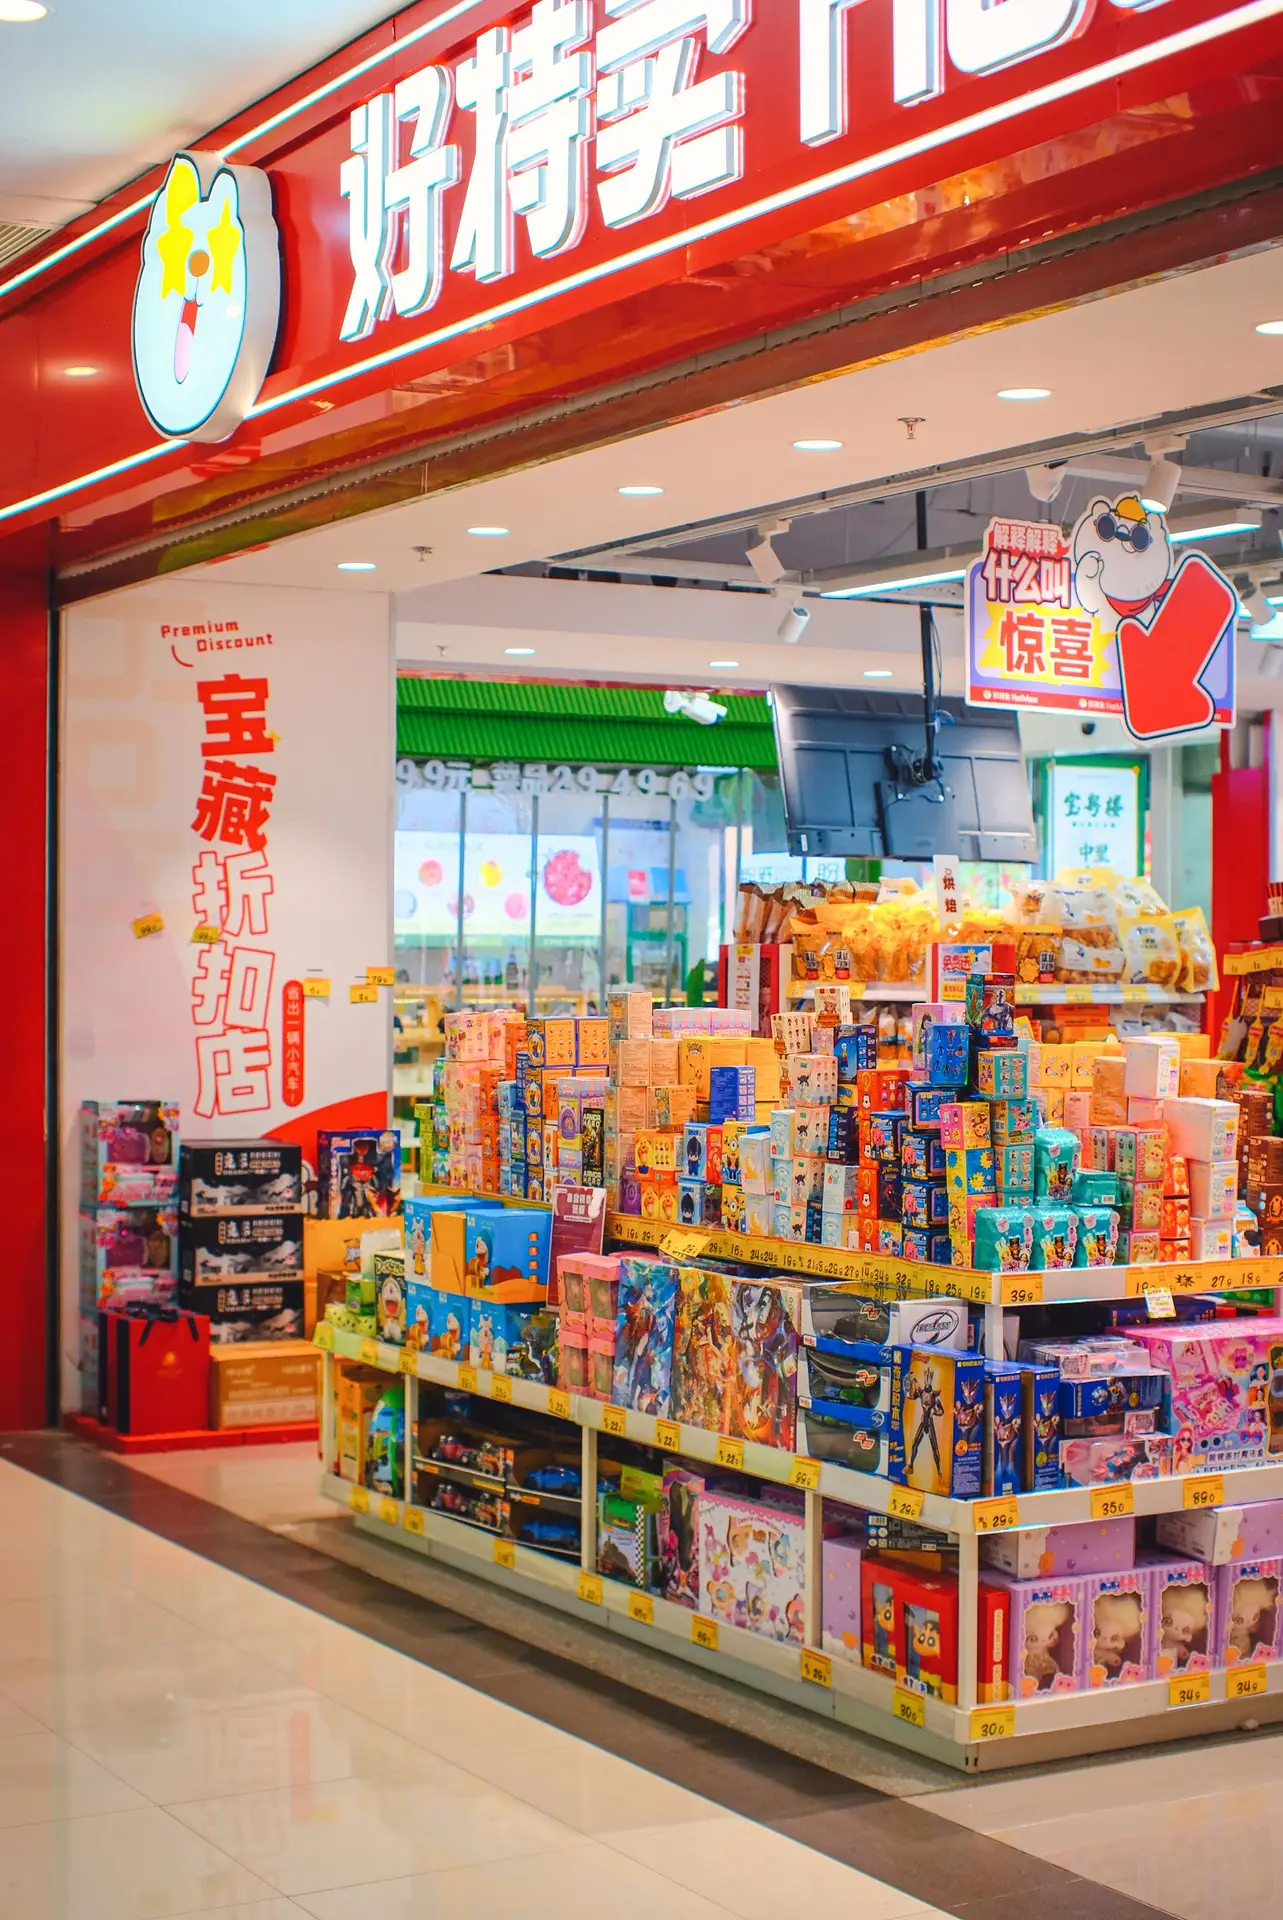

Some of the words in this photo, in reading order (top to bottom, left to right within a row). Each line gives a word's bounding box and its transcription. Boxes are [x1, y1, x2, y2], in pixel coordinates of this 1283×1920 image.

[993, 522, 1059, 553] 解释解释
[981, 550, 1071, 607] 什么叫
[161, 620, 239, 638] Premium
[197, 633, 274, 653] Discount
[999, 610, 1093, 680] 惊喜
